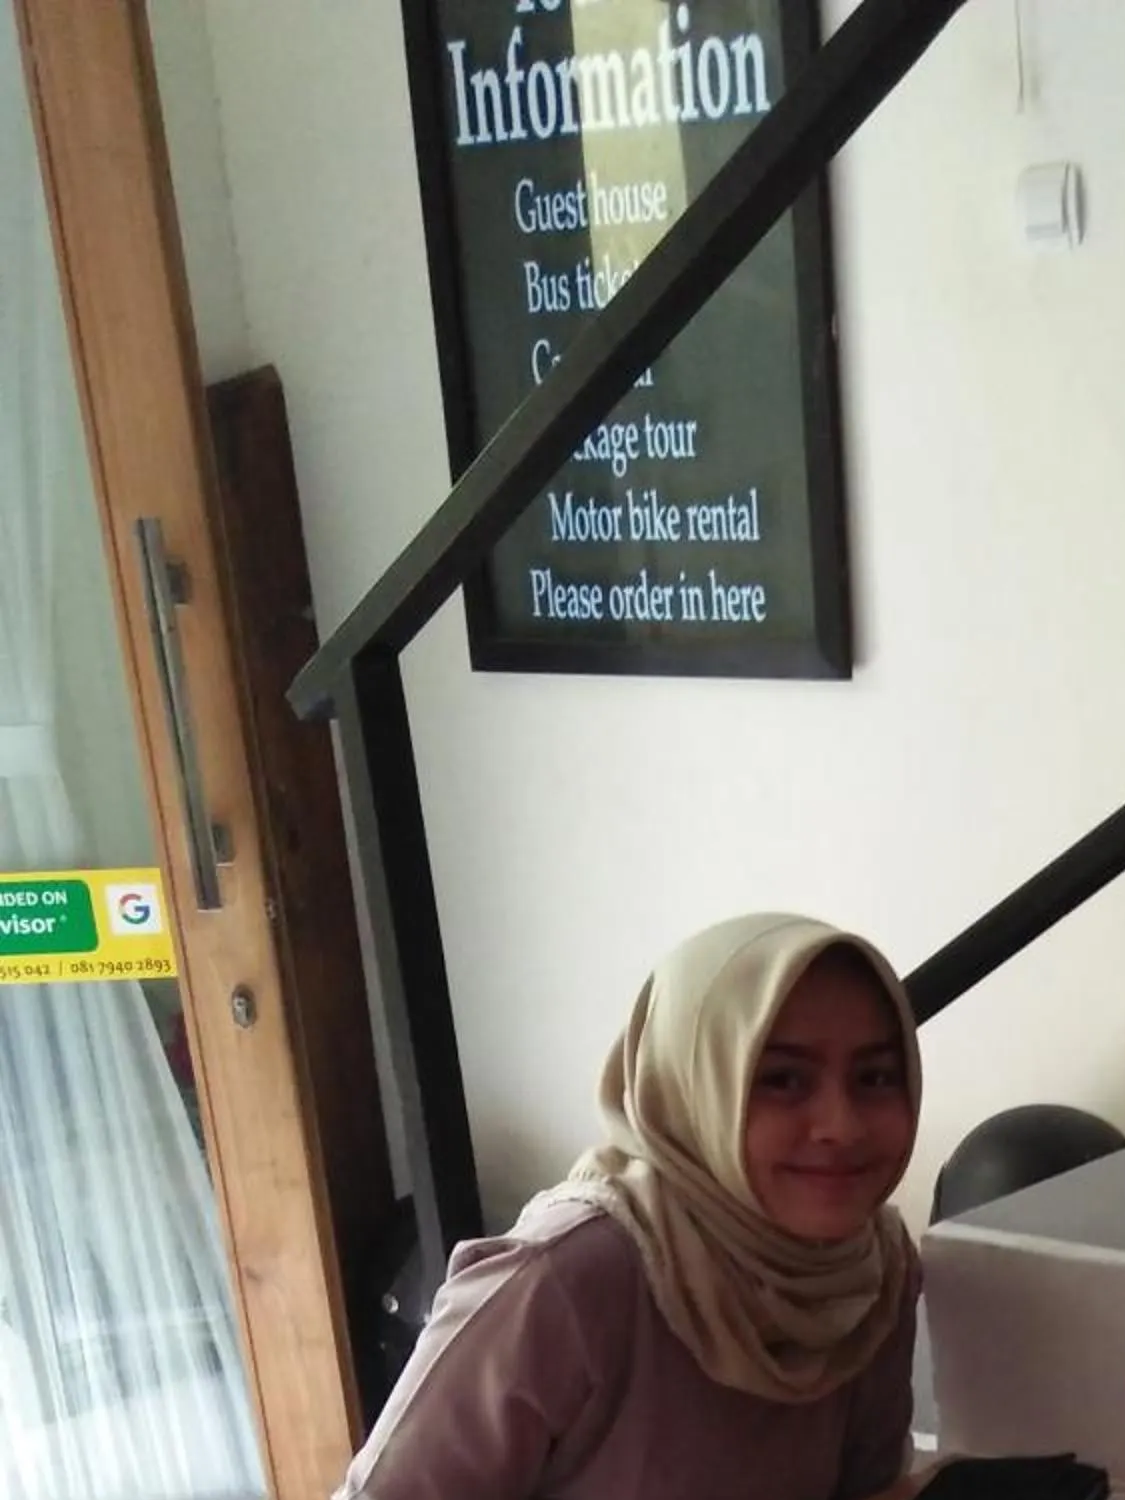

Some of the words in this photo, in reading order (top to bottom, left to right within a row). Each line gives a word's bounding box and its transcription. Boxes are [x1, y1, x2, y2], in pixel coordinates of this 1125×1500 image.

[448, 3, 772, 146] Information
[515, 178, 588, 234] Guest
[590, 171, 668, 226] house
[524, 260, 571, 313] Bus
[575, 252, 640, 310] tick
[644, 413, 698, 459] tour
[548, 490, 622, 541] Motor
[626, 489, 680, 541] bike
[687, 488, 761, 541] rental
[529, 568, 603, 619] Please
[608, 569, 674, 622] order
[678, 573, 706, 621] in
[708, 570, 767, 623] here
[41, 890, 68, 905] ON
